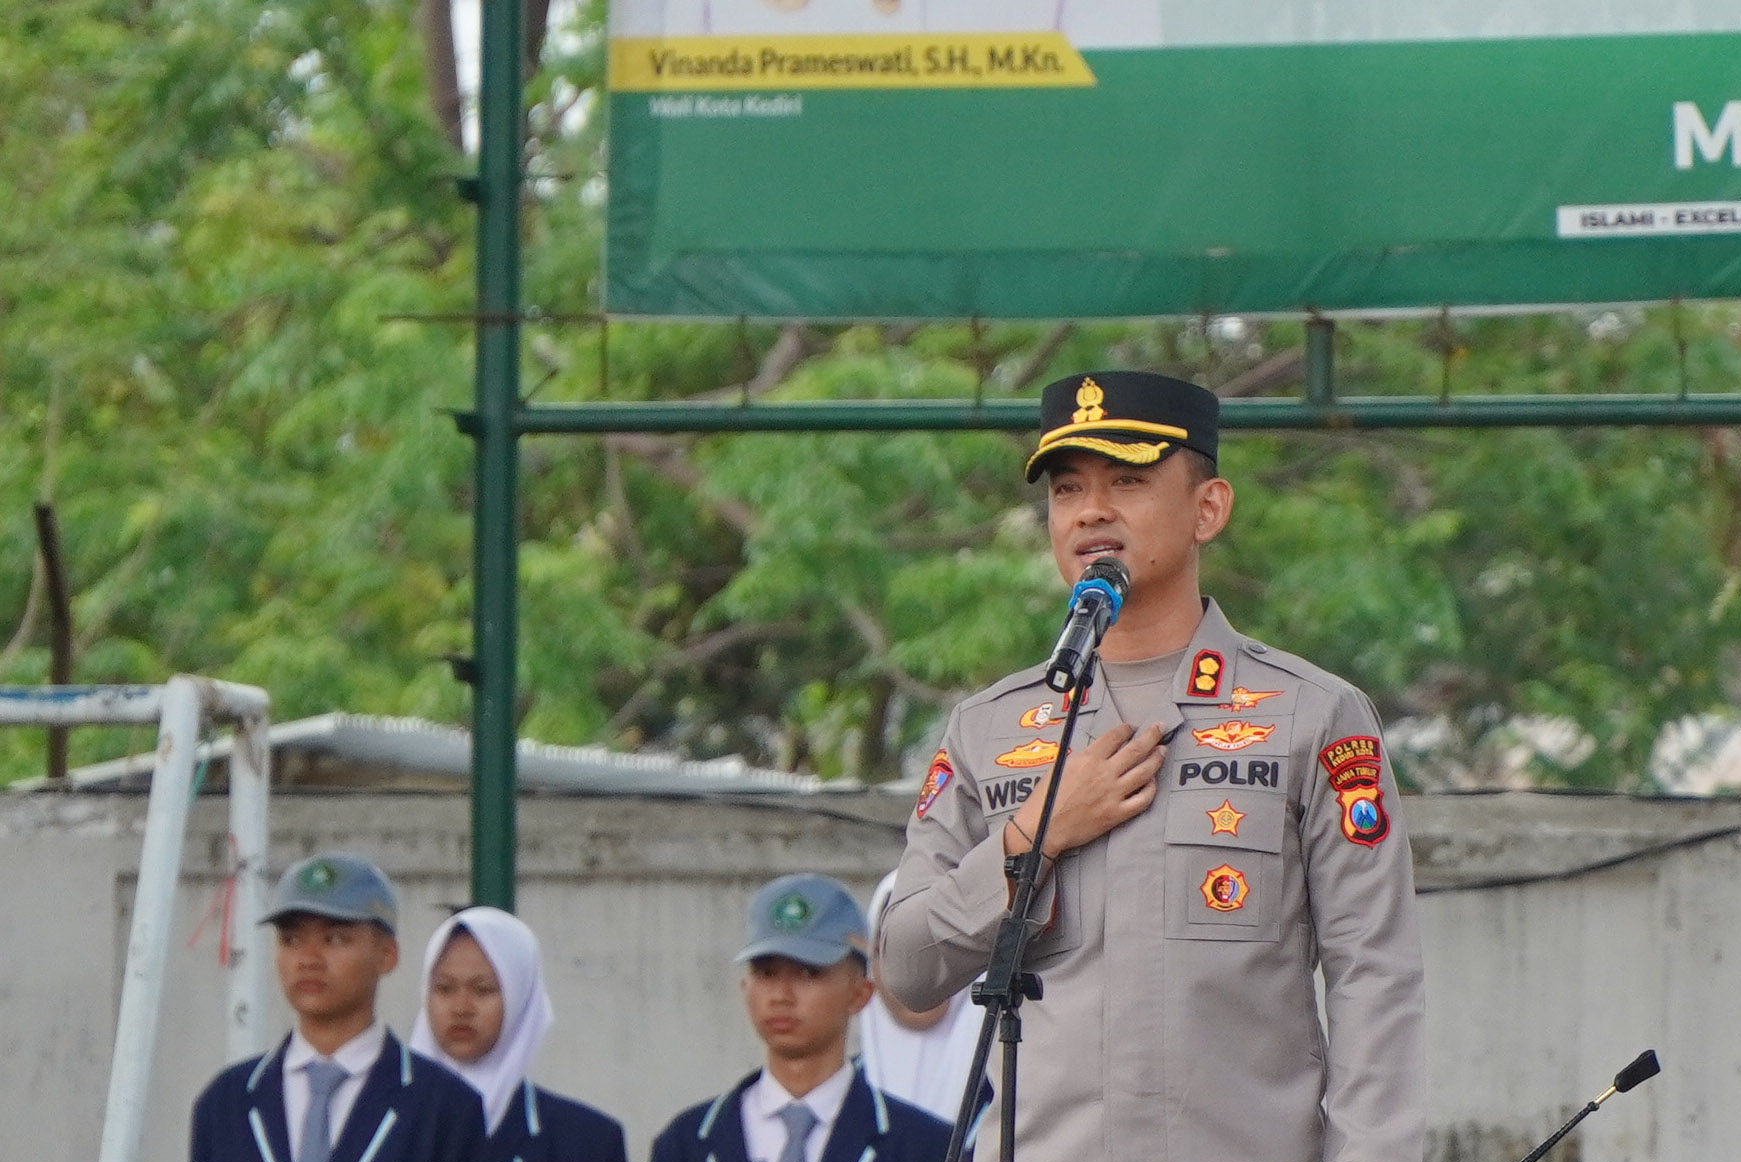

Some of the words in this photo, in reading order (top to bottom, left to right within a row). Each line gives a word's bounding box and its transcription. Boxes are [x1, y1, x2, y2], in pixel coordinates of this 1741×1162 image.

[649, 48, 753, 75] Vinanda
[1580, 210, 1654, 229] ISLAMI
[1327, 739, 1374, 760] POLRES
[1179, 761, 1279, 788] POLRI
[985, 776, 1041, 810] WIS
